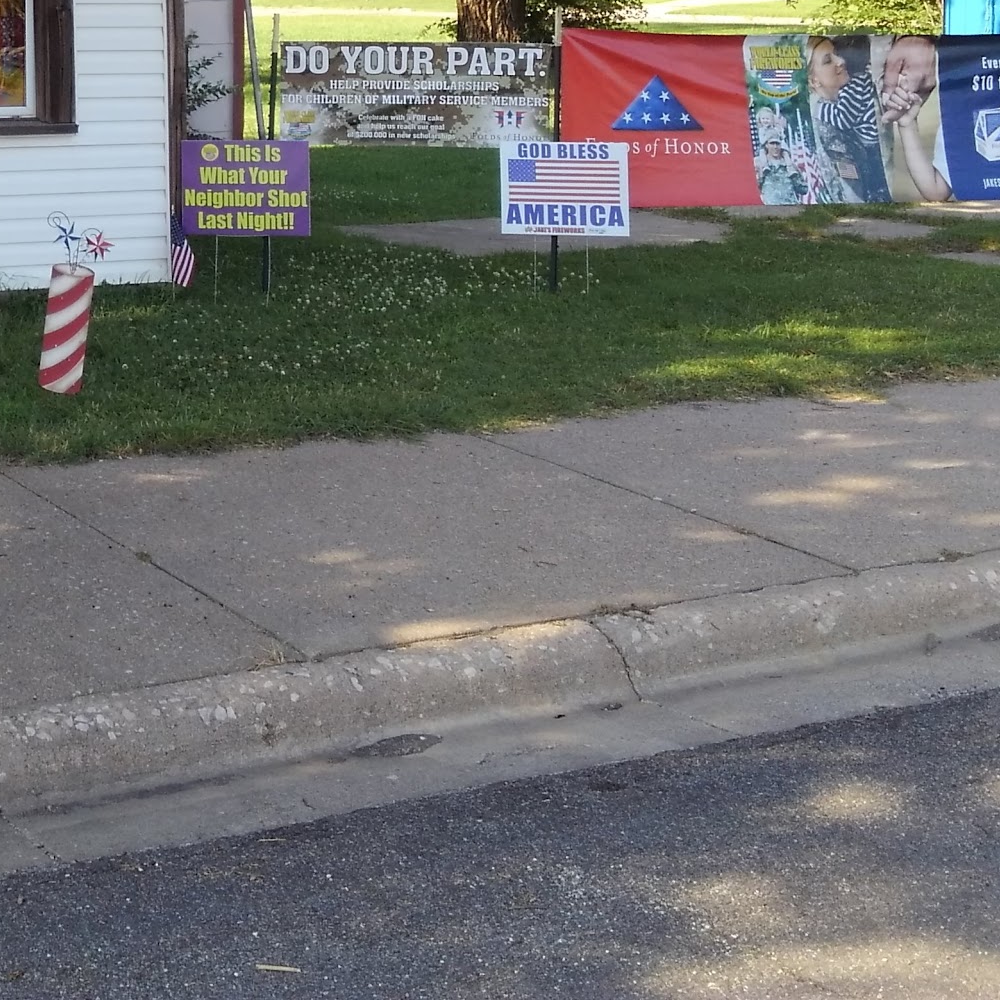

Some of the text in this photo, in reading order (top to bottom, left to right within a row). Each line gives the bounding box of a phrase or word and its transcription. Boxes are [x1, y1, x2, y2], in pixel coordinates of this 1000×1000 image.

[285, 46, 546, 76] DO YOUR PART.
[330, 80, 500, 91] HELP PROVIDE SCHOLARSHIPS
[972, 74, 994, 92] $10
[282, 94, 549, 107] FOR CHILDREN OF MILITARY SERVICE MEMBERS
[427, 114, 444, 122] cake
[224, 144, 281, 162] This Is
[518, 143, 551, 158] GOD
[557, 144, 609, 159] BLESS
[645, 138, 660, 157] of
[664, 138, 731, 154] HONOR
[200, 167, 287, 184] What Your
[185, 189, 308, 208] Neighbor Shot
[198, 211, 294, 231] Last Night!!
[507, 204, 624, 226] AMERICA
